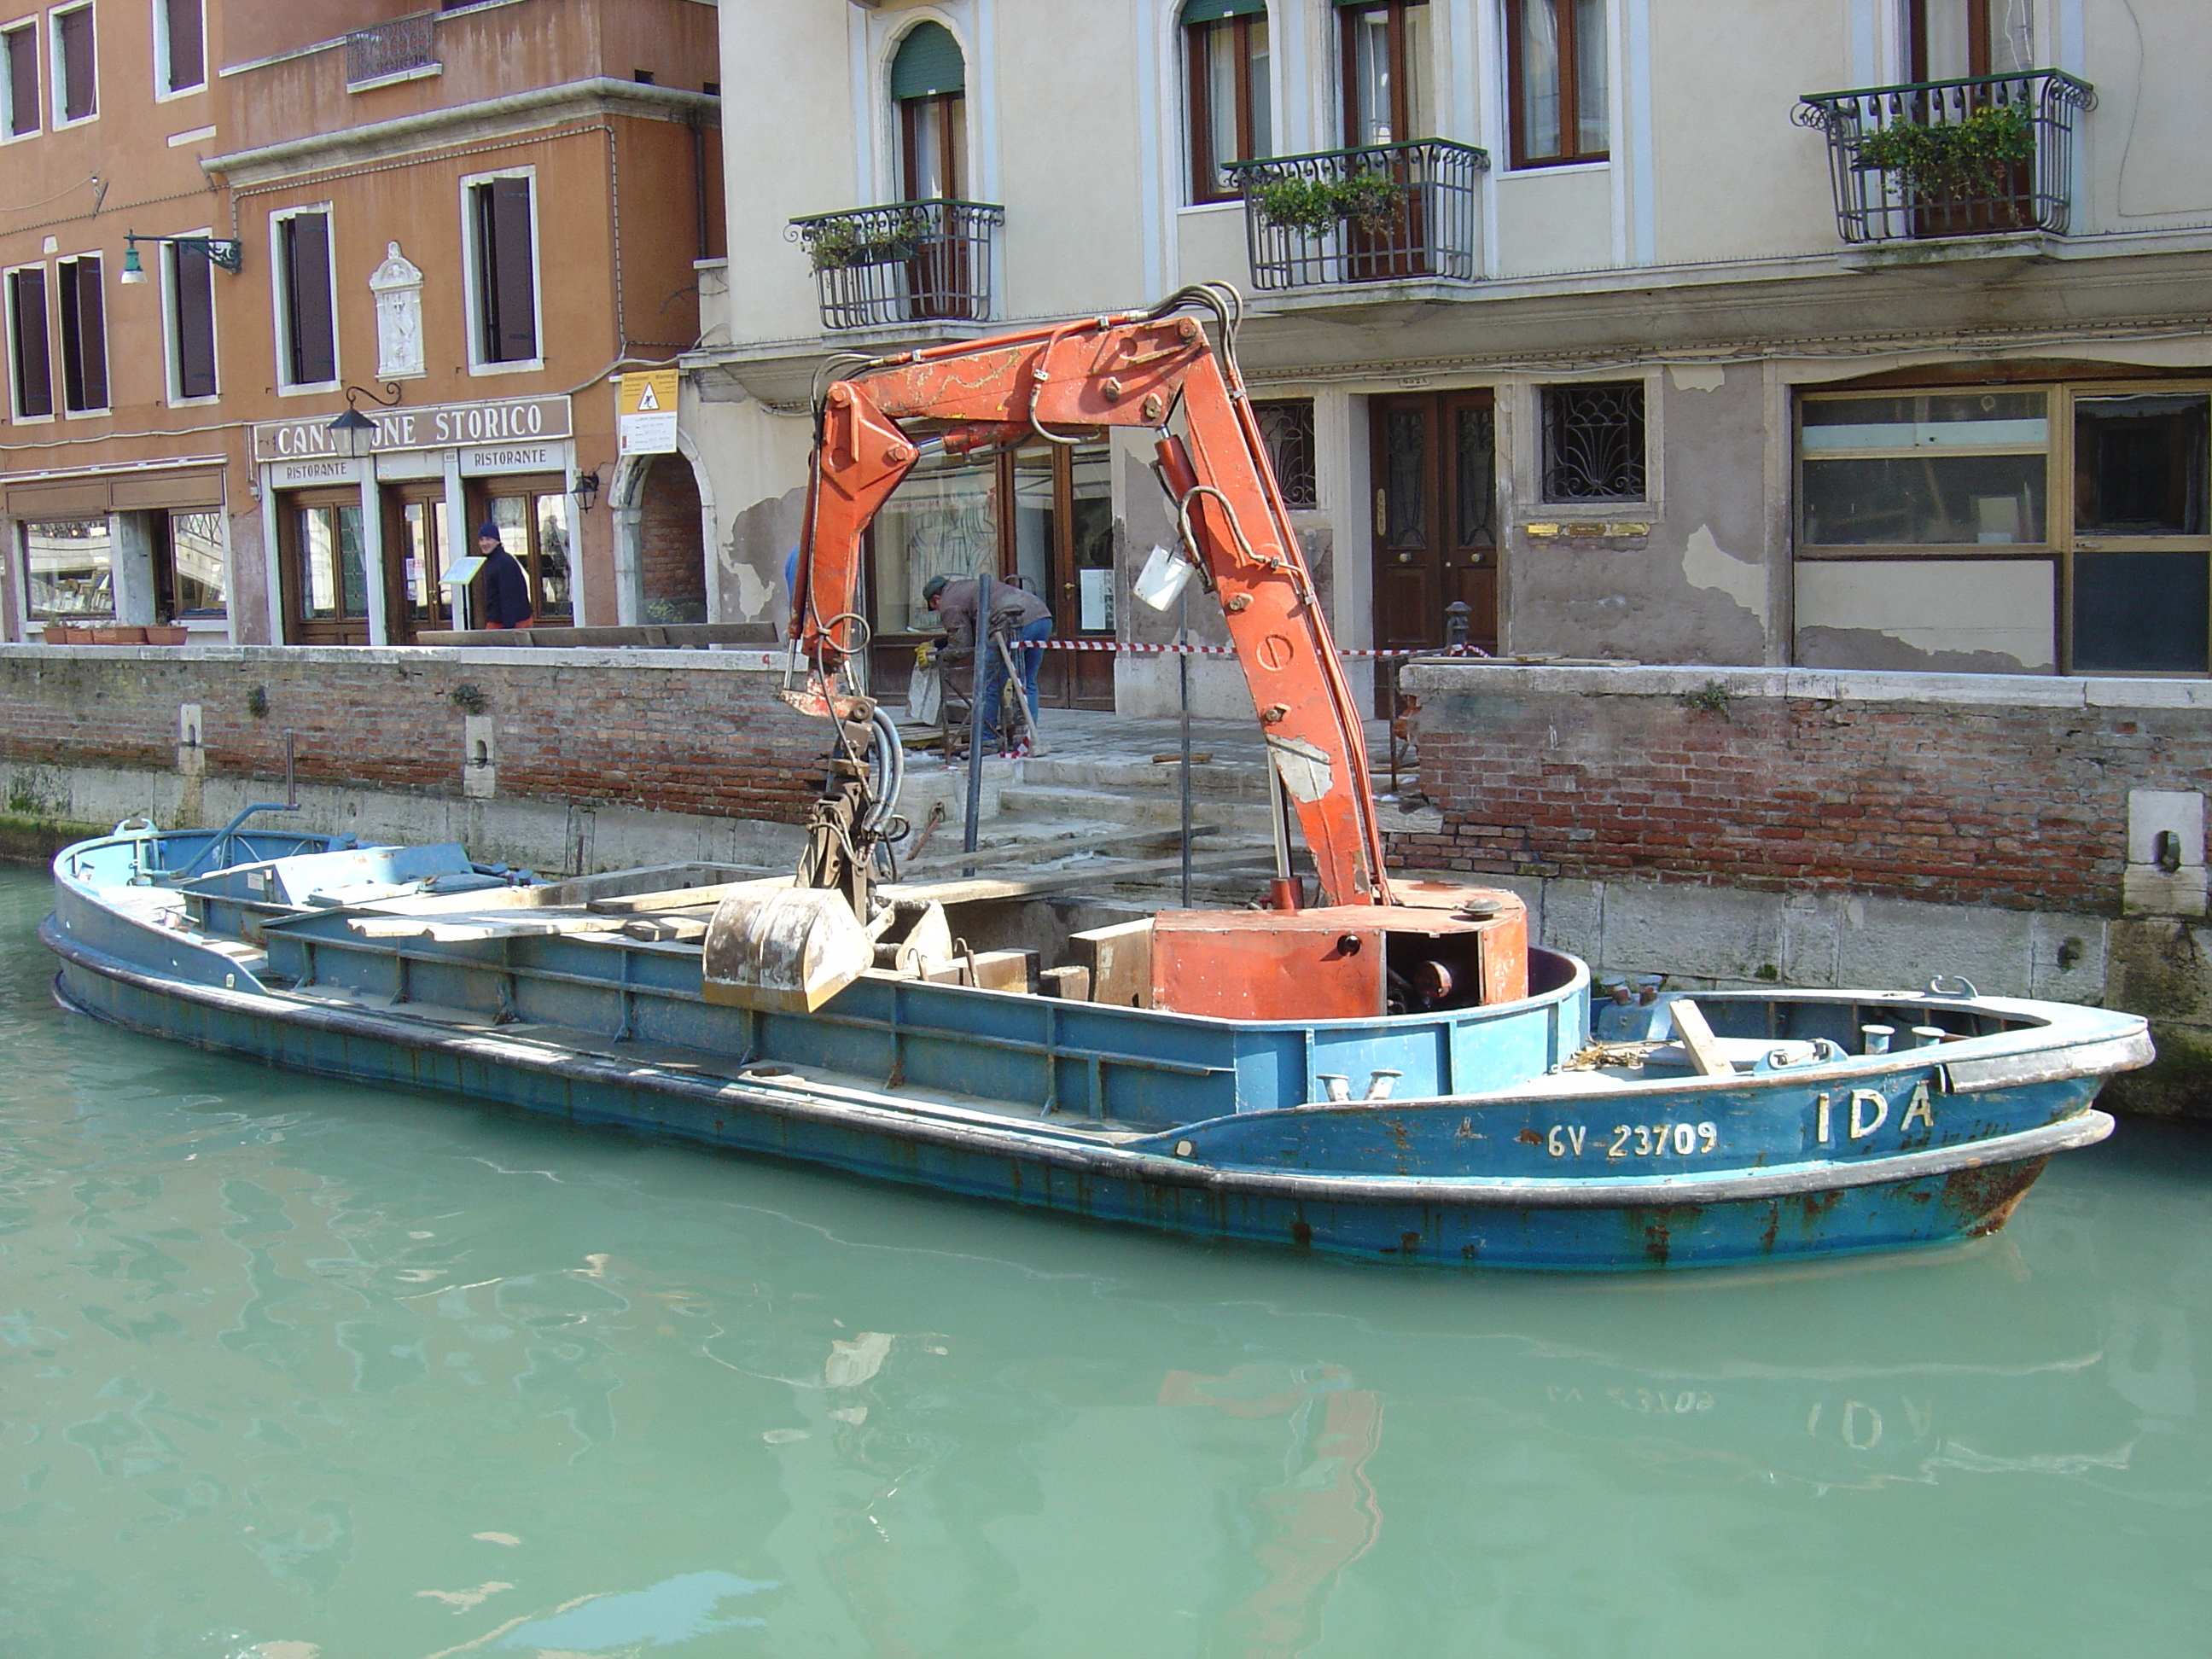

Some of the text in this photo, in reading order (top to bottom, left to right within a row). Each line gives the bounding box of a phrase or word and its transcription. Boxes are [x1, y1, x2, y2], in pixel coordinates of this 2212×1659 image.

[277, 404, 542, 455] CANONE STORICO
[286, 463, 347, 480] RISTORANTE
[474, 449, 547, 467] RISTORANTE
[1818, 1080, 1934, 1143] IDA
[1608, 1121, 1717, 1157] 23709
